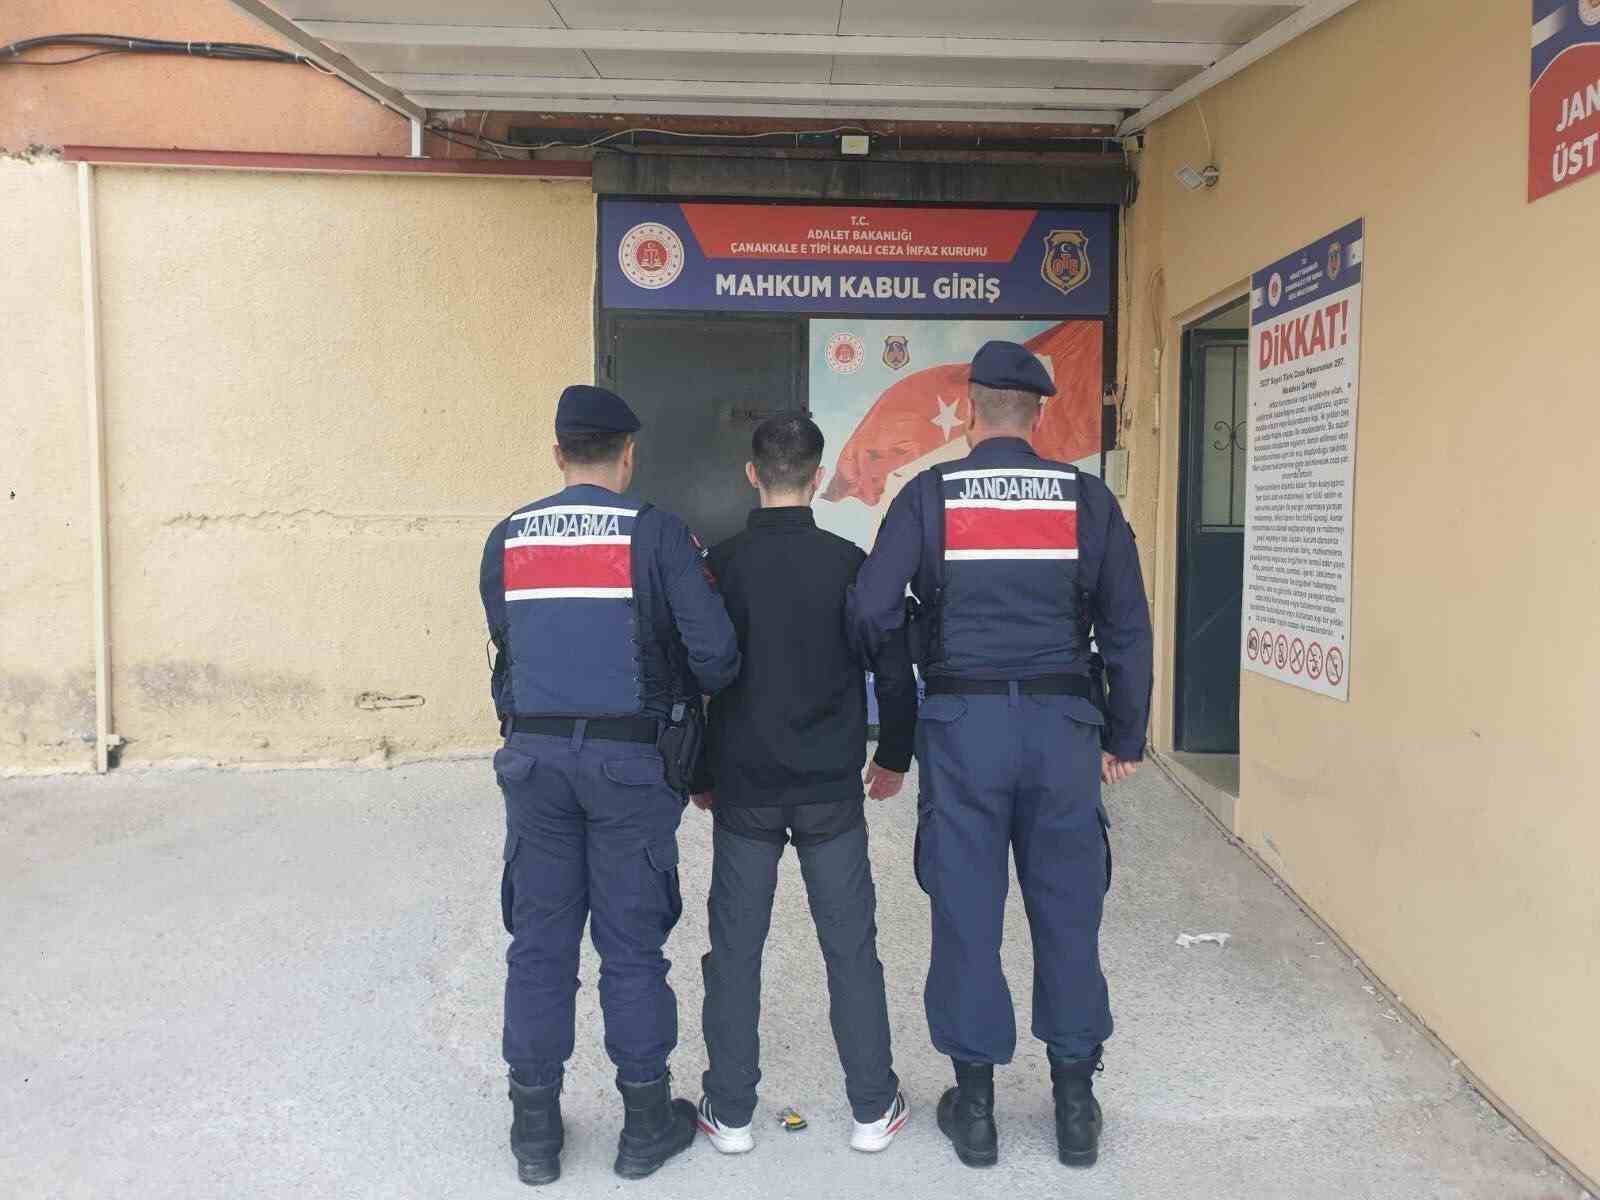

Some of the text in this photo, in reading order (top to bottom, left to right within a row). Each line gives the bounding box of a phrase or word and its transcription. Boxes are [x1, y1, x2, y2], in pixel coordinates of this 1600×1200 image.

[1552, 133, 1599, 182] ÜST
[850, 215, 869, 226] T.C.
[807, 228, 912, 241] ADALET BAKANLIĞI
[730, 242, 988, 256] ÇANAKKALE E TİPİ KAPALI CEZA İNFAZ KURUMU
[715, 272, 1001, 303] MAHKUM KABUL GİRİŞ
[1260, 301, 1349, 370] DİKKAT!
[959, 477, 1063, 500] JANDARMA
[517, 513, 620, 537] JANDARMA
